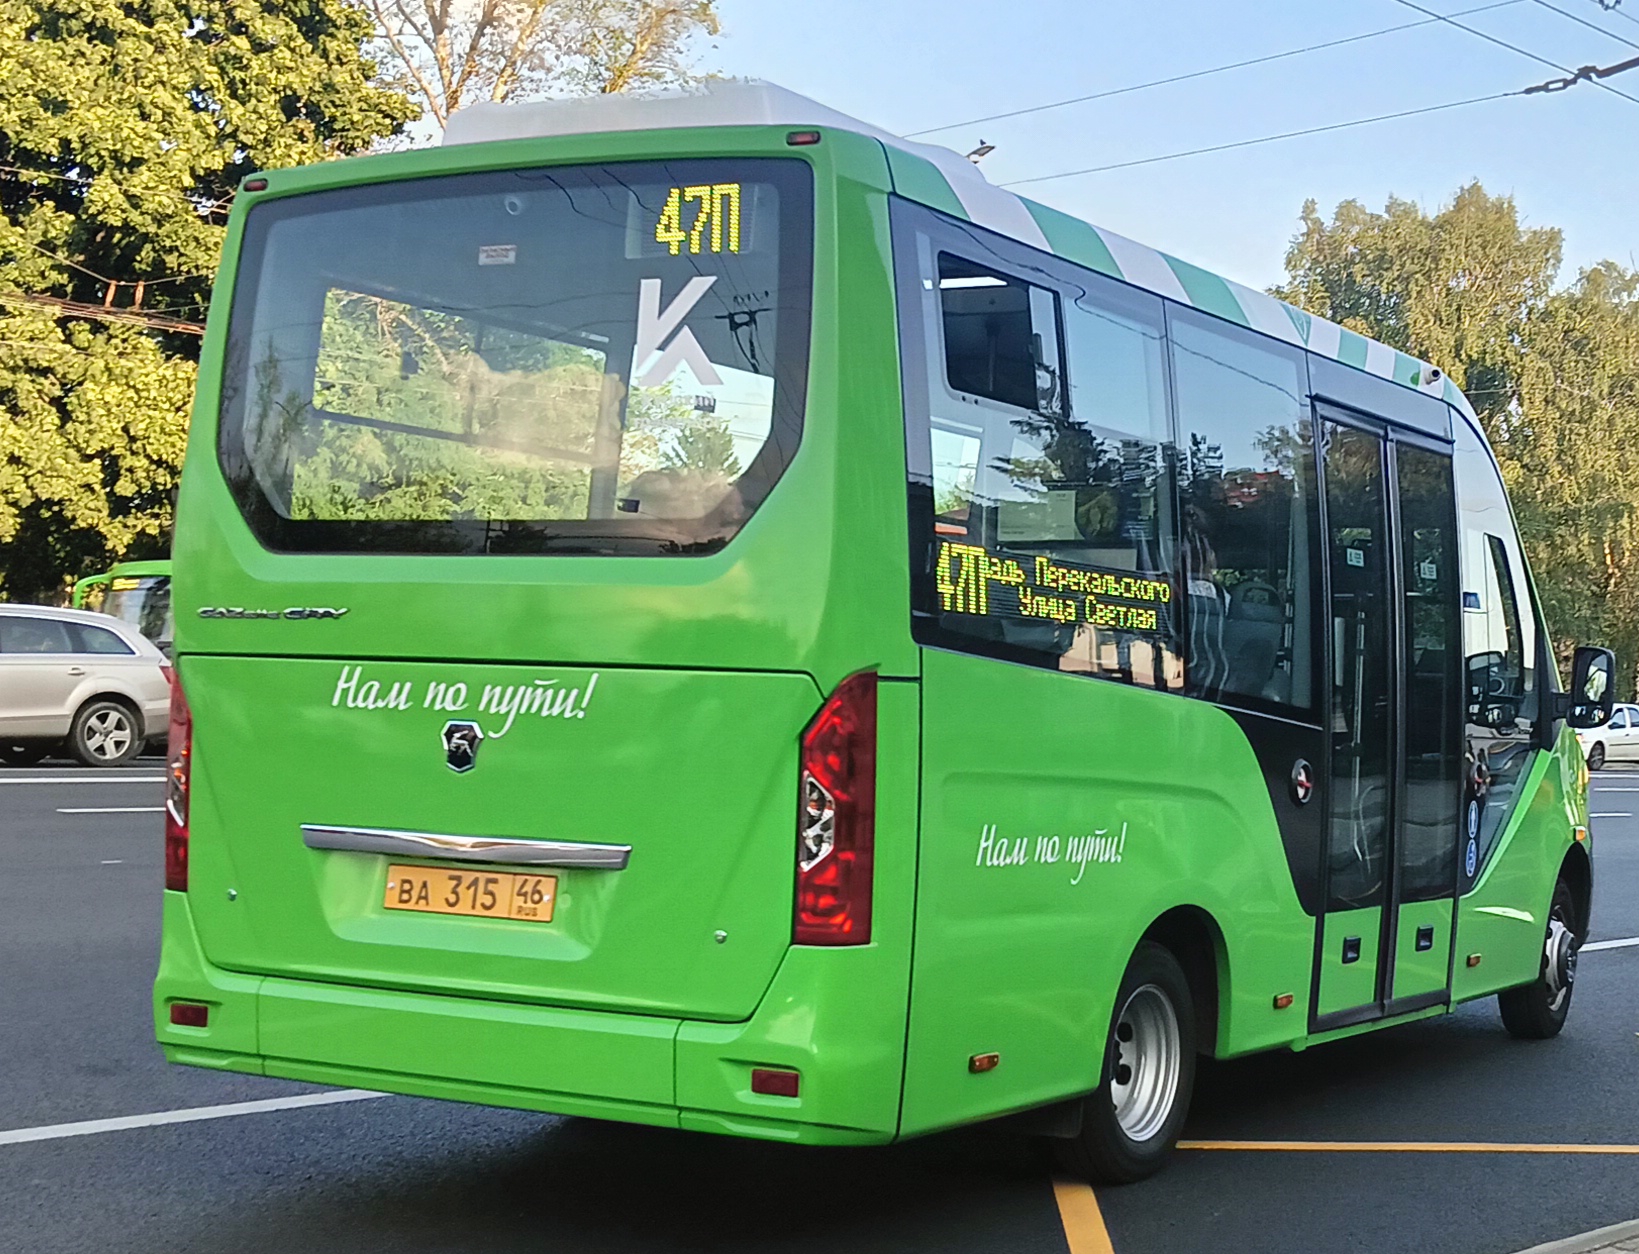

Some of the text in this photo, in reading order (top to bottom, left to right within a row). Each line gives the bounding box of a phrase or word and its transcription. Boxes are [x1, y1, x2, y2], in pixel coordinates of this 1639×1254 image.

[655, 183, 741, 255] 47П
[936, 541, 988, 616] 47П
[985, 555, 1171, 603] адь Перекальского
[1018, 585, 1158, 630] Улица Светлая
[331, 665, 600, 739] Нам по пути!
[975, 821, 1128, 886] Нам по пути!
[444, 874, 500, 911] 315
[515, 878, 544, 905] 46
[515, 905, 539, 917] RUS
